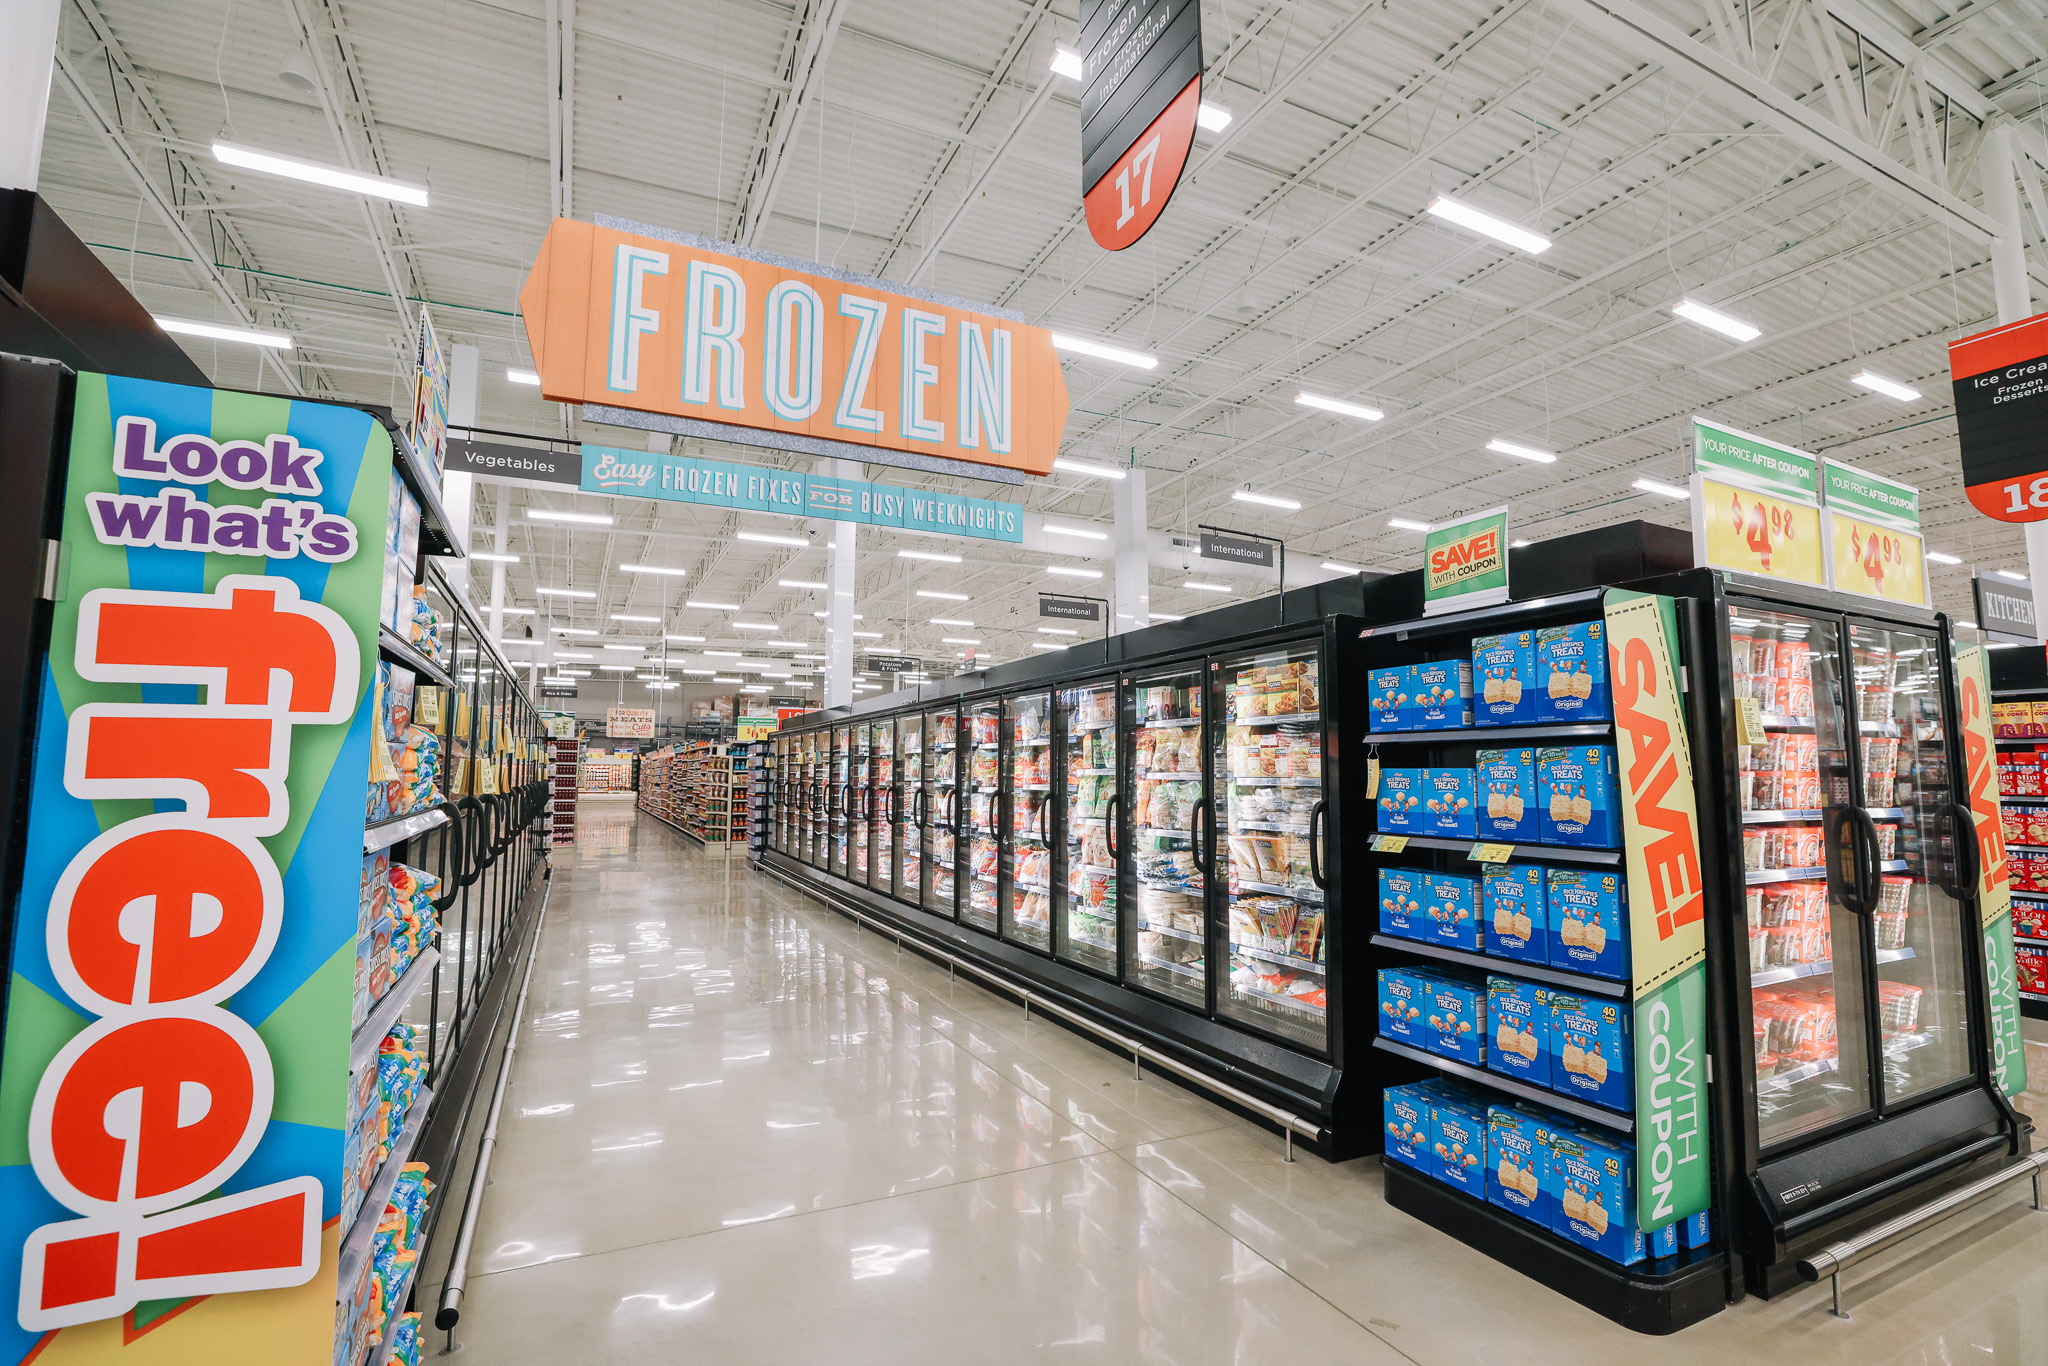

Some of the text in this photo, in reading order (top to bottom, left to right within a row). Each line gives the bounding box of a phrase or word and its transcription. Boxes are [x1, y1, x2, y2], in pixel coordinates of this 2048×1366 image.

[1090, 5, 1137, 76] Frozen
[1114, 15, 1152, 68] Frozen
[1100, 5, 1170, 102] International
[1116, 132, 1161, 231] 17
[605, 241, 1012, 456] FROZEN
[1974, 375, 2000, 389] Ice
[1998, 378, 2043, 395] Frozen
[121, 421, 318, 491] Look
[464, 451, 556, 473] Vegetables
[1703, 437, 1810, 480] YOUR PRICE AFTER COUPON
[592, 453, 1014, 534] Easy FROZEN FIXES FOR BUSY WEEKNIGHTS
[1830, 475, 1914, 511] YOUR PRICE AFTER COUPON
[2003, 477, 2048, 514] 18
[93, 493, 353, 557] what's
[1211, 543, 1264, 560] International
[1431, 531, 1496, 574] SAVE!
[1433, 556, 1497, 584] WITH COUPON
[1047, 605, 1092, 617] International
[1985, 591, 2035, 626] KITCHEN
[1588, 623, 1601, 632] 40
[1519, 633, 1530, 641] 40
[1552, 647, 1584, 658] TREATS
[1486, 654, 1515, 666] TREATS
[1377, 679, 1400, 689] TREATS
[1422, 675, 1446, 685] TREATS
[1491, 704, 1514, 713] Original
[1555, 700, 1582, 709] Original
[1521, 751, 1531, 759] 40
[1586, 749, 1599, 758] 40
[1490, 770, 1517, 780] TREATS
[1552, 770, 1583, 780] TREATS
[1387, 782, 1410, 790] TREATS
[1434, 782, 1460, 791] TREATS
[1608, 636, 1706, 942] SAVE!
[1961, 676, 2009, 893] SAVE!
[1494, 821, 1516, 830] Original
[1558, 824, 1583, 833] Original
[1528, 869, 1539, 879] 40
[1602, 876, 1615, 886] 40
[1389, 883, 1411, 894] TREATS
[1435, 890, 1460, 901] TREATS
[1496, 886, 1524, 898] TREATS
[1564, 894, 1599, 907] TREATS
[35, 583, 344, 1315] free!
[1501, 938, 1523, 947] Original
[1569, 949, 1595, 960] Original
[1388, 986, 1412, 1000] TREATS
[1535, 989, 1546, 999] 40
[1436, 999, 1462, 1013] TREATS
[1501, 1002, 1531, 1016] TREATS
[1602, 1006, 1616, 1016] 40
[2000, 964, 2019, 1056] WITH
[1984, 935, 2009, 1092] COUPON
[1565, 1020, 1598, 1035] TREATS
[1504, 1054, 1528, 1067] Original
[1571, 1075, 1598, 1089] Original
[1674, 1036, 1699, 1166] WITH
[1394, 1107, 1418, 1124] TREATS
[1648, 1000, 1675, 1222] COUPON
[1442, 1127, 1469, 1146] TREATS
[1536, 1128, 1548, 1139] 40
[1502, 1137, 1531, 1155] TREATS
[1605, 1157, 1619, 1169] 40
[1566, 1165, 1600, 1185] TREATS
[1505, 1190, 1529, 1206] Original
[1571, 1222, 1598, 1240] Original
